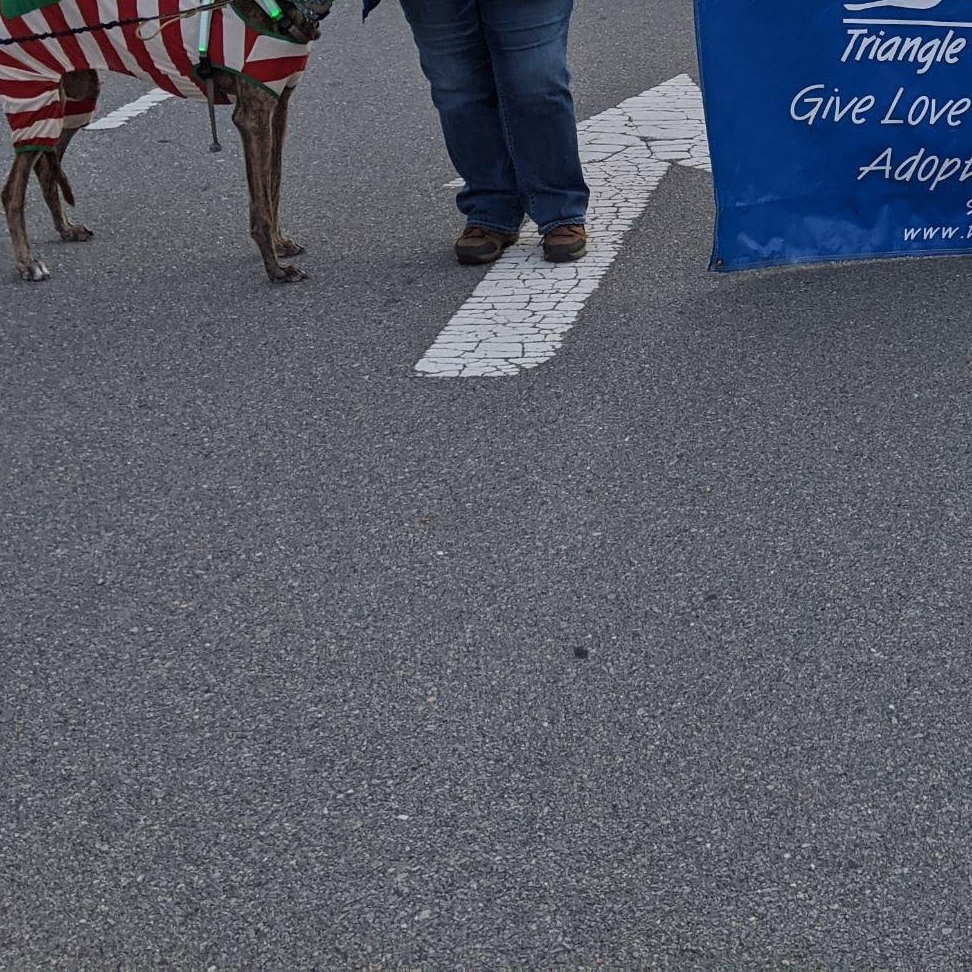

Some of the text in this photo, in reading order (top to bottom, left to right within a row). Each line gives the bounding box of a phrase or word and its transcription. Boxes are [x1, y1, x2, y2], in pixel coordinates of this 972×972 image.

[840, 28, 967, 74] Triangle
[789, 84, 875, 125] Give
[880, 87, 972, 127] Love
